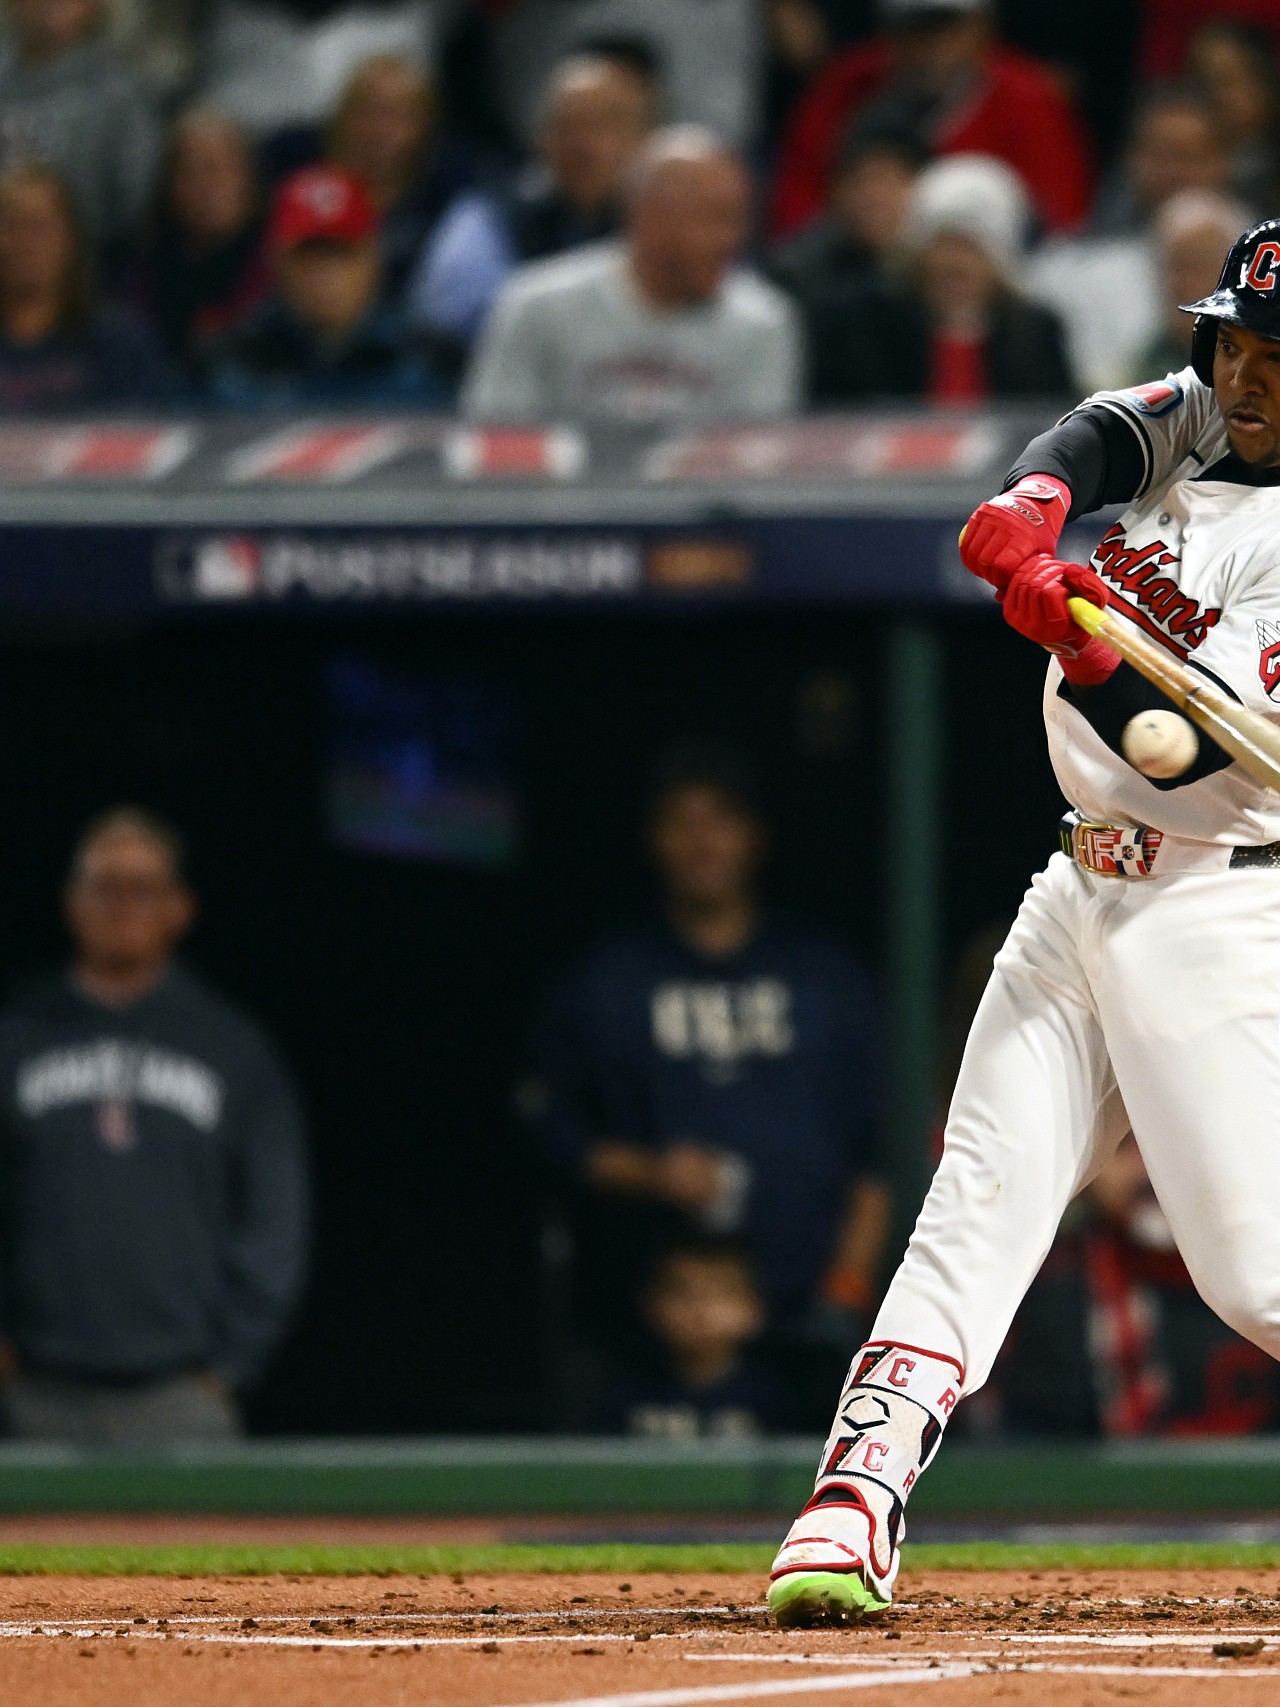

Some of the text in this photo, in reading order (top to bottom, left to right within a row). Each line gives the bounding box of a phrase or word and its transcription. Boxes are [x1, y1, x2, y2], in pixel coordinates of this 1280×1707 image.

[887, 1358, 916, 1387] C
[937, 1387, 957, 1415] R
[862, 1442, 889, 1472] C
[903, 1468, 916, 1494] R
